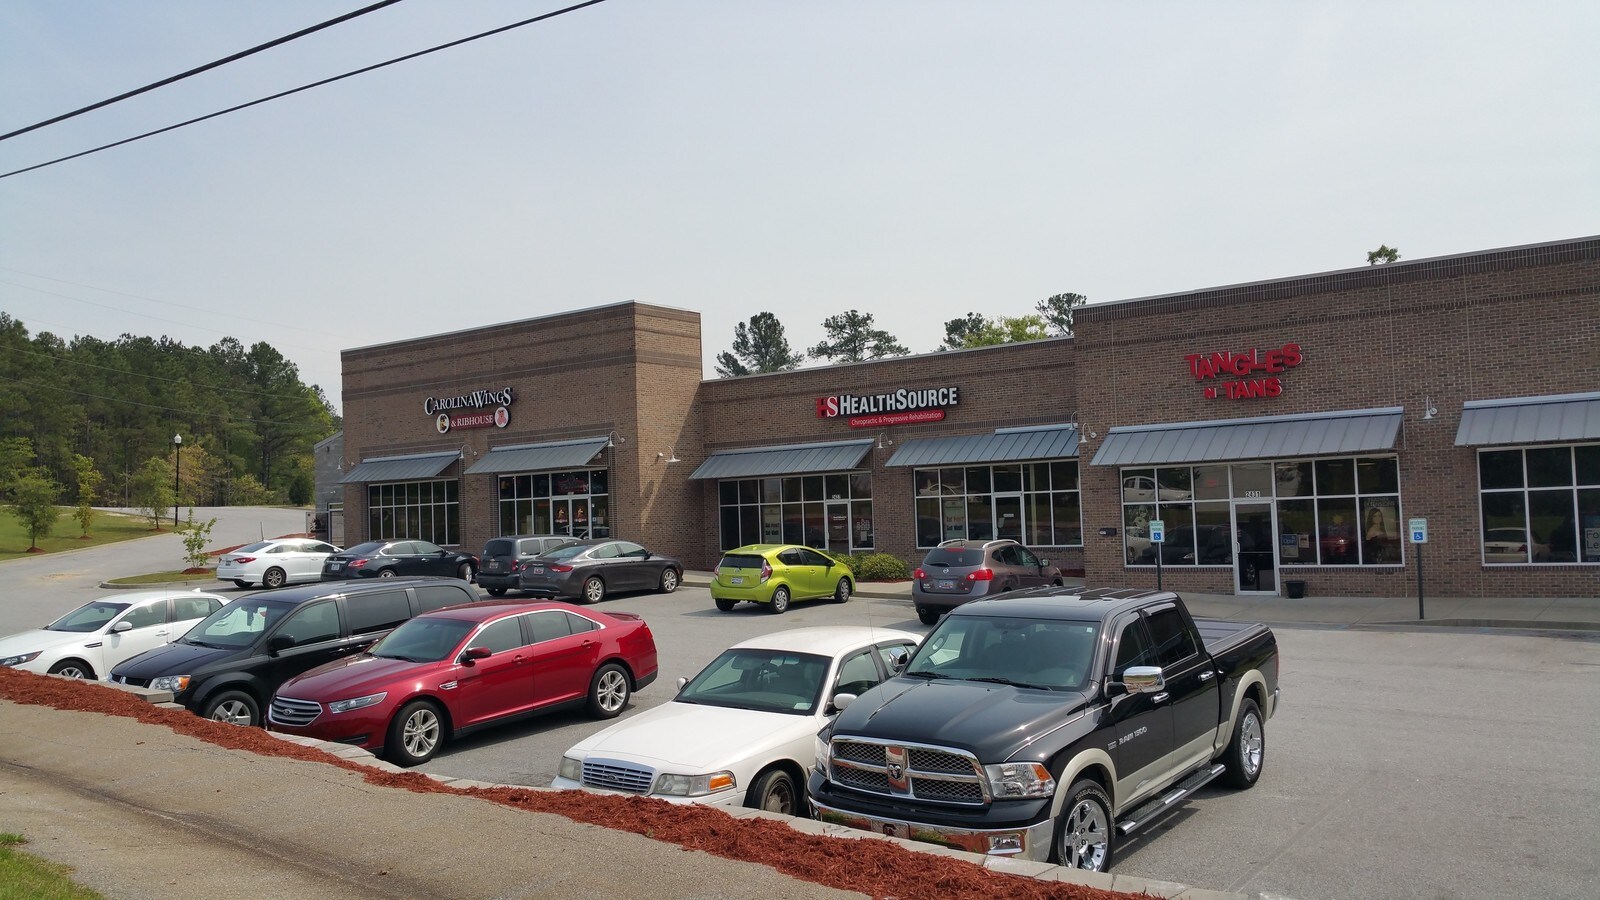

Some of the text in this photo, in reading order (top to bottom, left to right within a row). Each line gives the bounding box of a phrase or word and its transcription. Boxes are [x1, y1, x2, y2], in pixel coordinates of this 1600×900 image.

[1184, 343, 1303, 380] TANGLES
[1222, 377, 1283, 399] TANS
[839, 387, 958, 415] HEALTHSOURCE
[457, 414, 494, 427] RIBHOUSE
[851, 417, 878, 427] Chiropractic
[883, 414, 909, 424] Progressive
[909, 411, 942, 421] Rehabilitation
[1118, 732, 1134, 745] RAM
